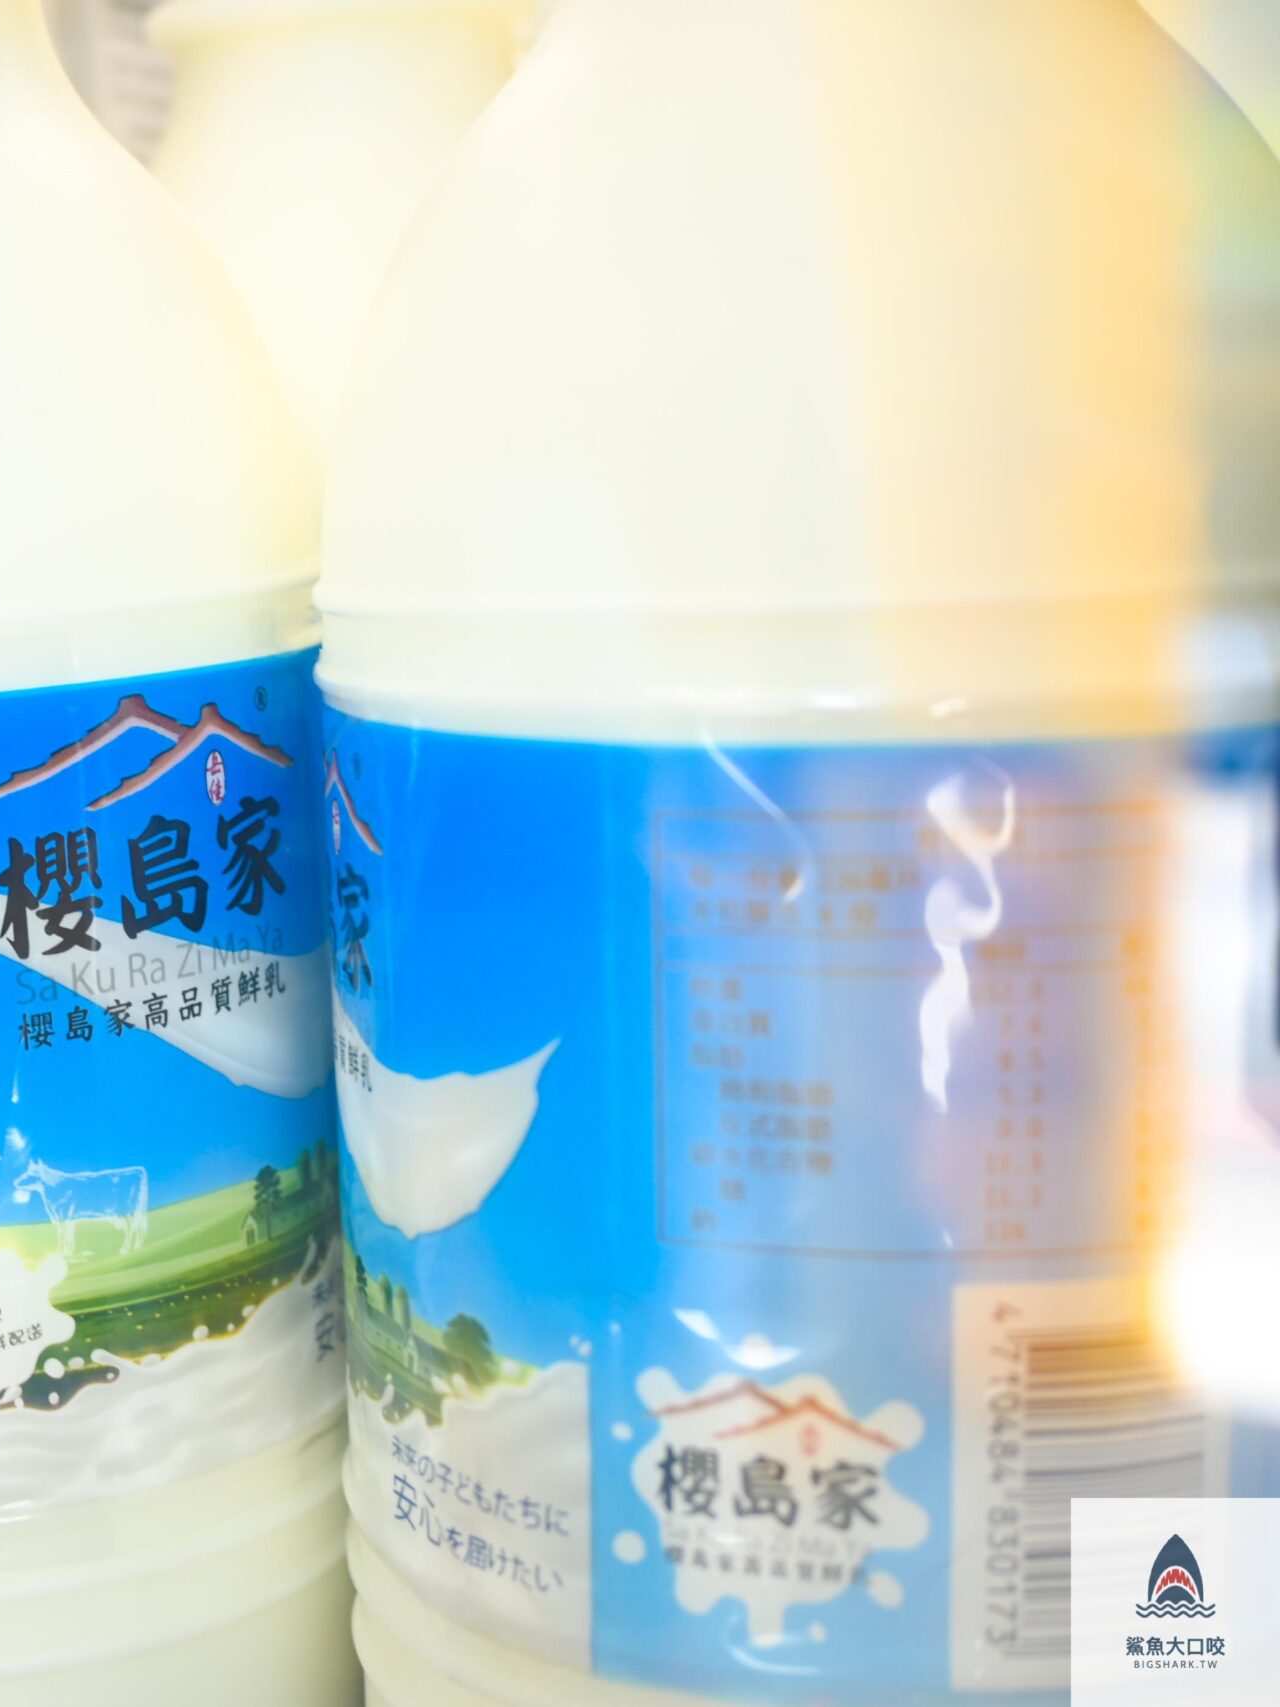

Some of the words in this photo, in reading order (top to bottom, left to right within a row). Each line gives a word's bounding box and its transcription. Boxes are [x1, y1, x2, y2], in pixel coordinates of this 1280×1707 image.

[16, 968, 58, 1005] Sa
[70, 959, 116, 998] Ku
[128, 951, 167, 989] Ra
[176, 941, 204, 980] Zi
[211, 932, 251, 971] Ma
[256, 924, 284, 952] Ya
[18, 960, 287, 1051] 櫻島家高品質鮮乳
[656, 1444, 881, 1531] 櫻島家
